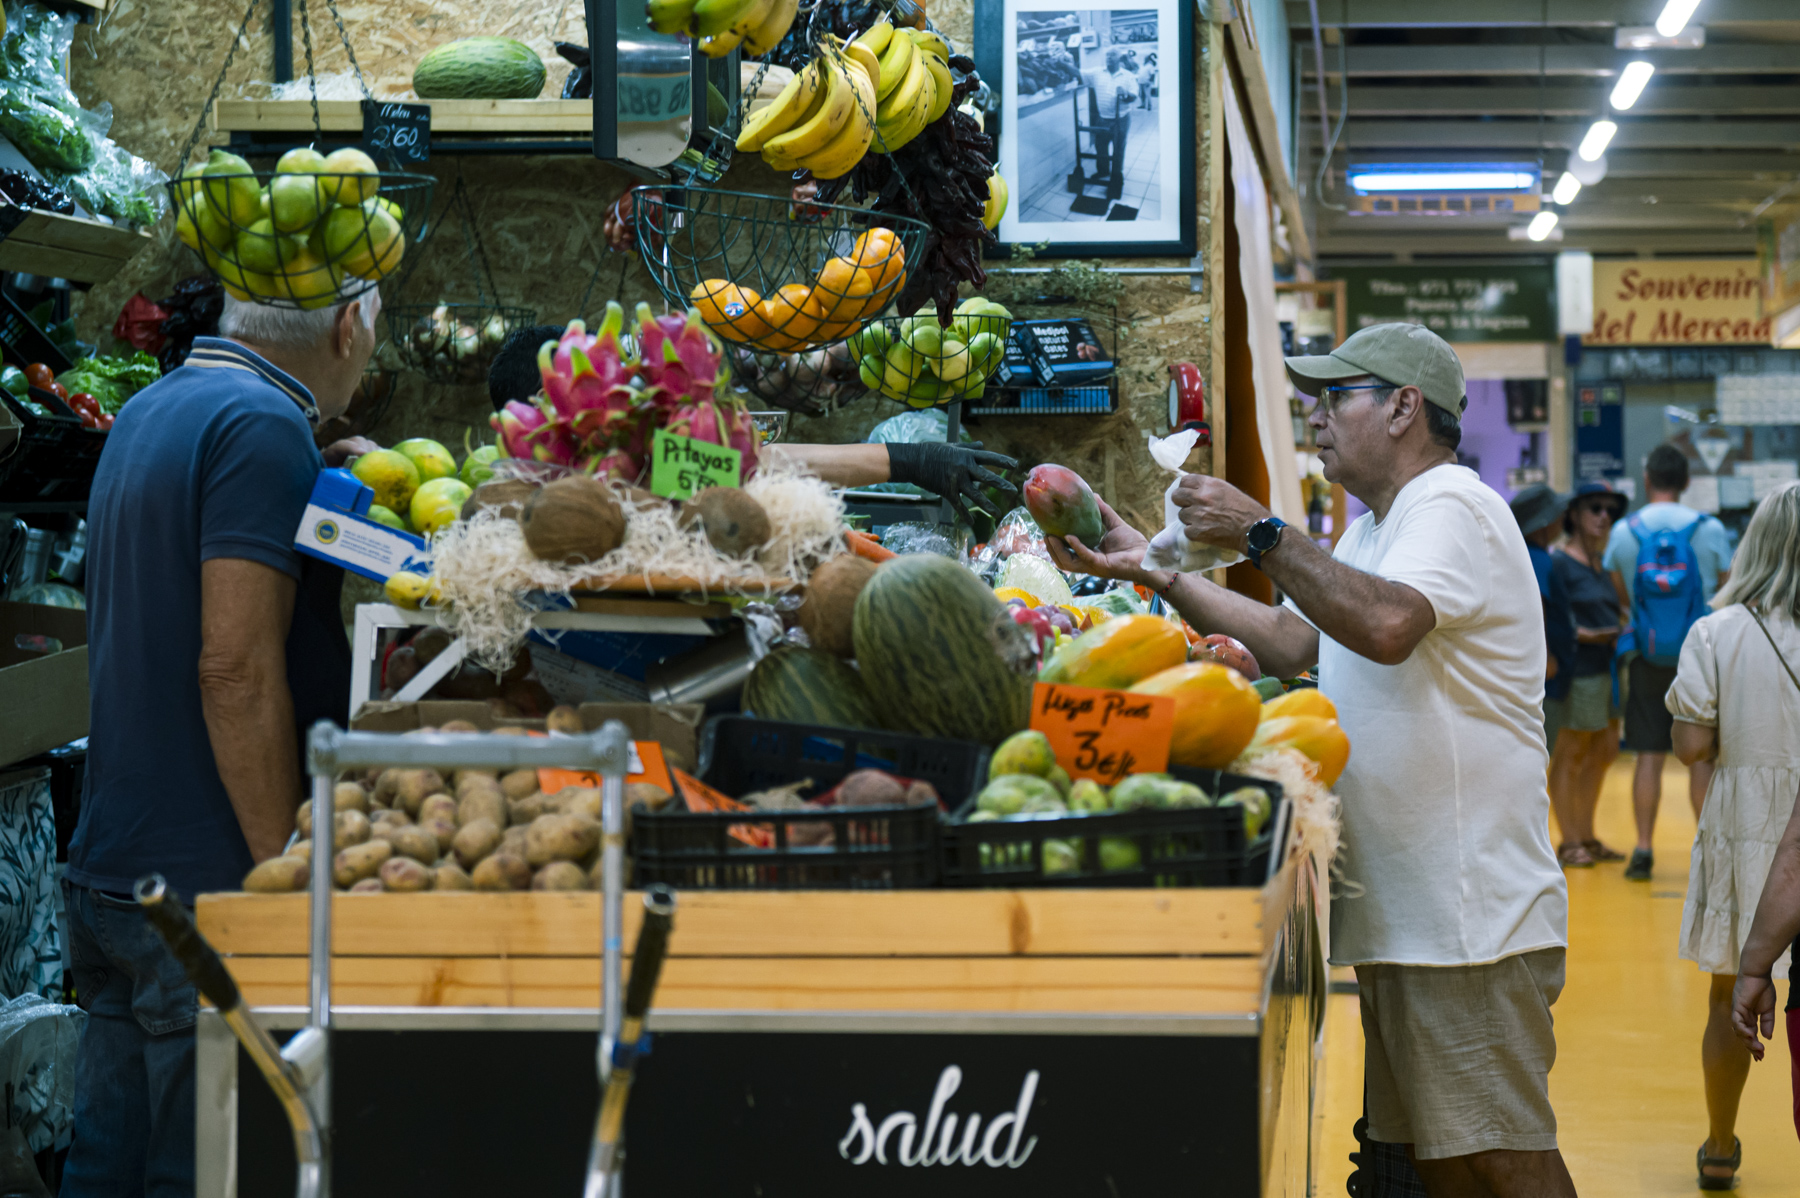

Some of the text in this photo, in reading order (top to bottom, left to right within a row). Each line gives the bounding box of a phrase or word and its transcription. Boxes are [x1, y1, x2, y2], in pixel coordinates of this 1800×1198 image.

[1032, 325, 1070, 337] Medjool
[1038, 335, 1070, 345] natural
[1043, 344, 1069, 354] dates
[663, 437, 734, 473] Pitayas
[838, 1064, 1040, 1169] salud
